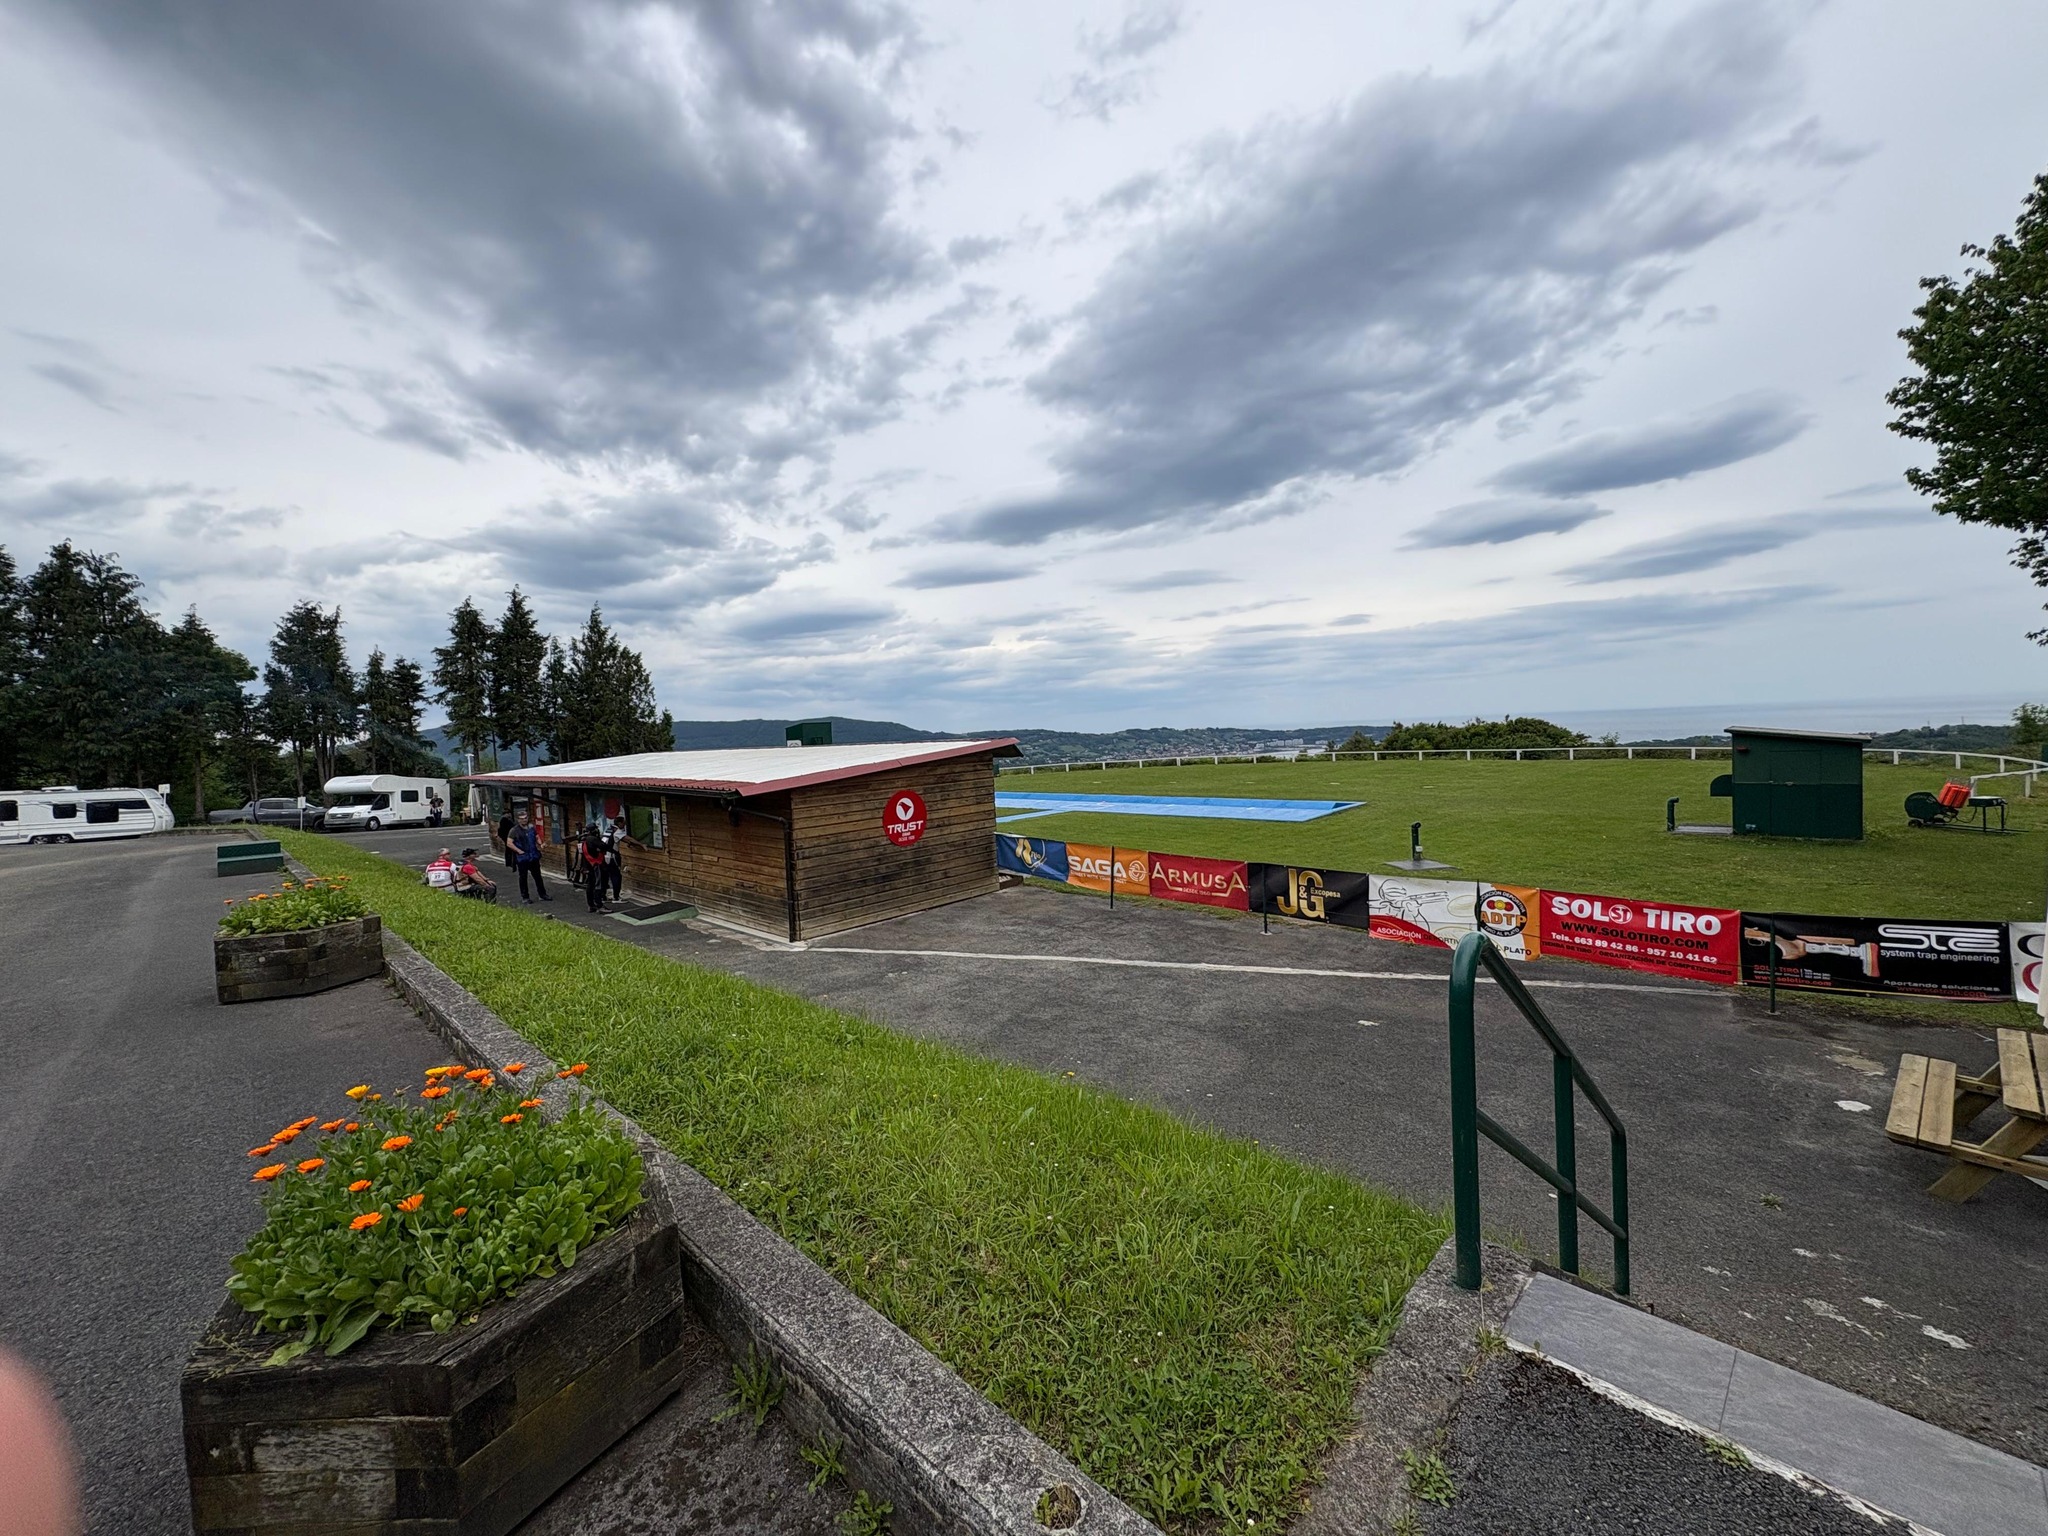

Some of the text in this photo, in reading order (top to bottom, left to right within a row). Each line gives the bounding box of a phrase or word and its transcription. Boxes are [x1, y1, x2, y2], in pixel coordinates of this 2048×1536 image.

[887, 820, 924, 834] TRUST
[1068, 855, 1127, 879] SAGA
[1152, 862, 1247, 897] ARMUSA
[1310, 887, 1341, 898] Excopesa
[1480, 910, 1527, 927] ADTP
[1643, 907, 1721, 936] TIRO
[1376, 926, 1460, 945] ASOCIACIÓN DEPORTIV
[1561, 921, 1709, 951] WWW.SOLOTIRO.COM
[1503, 945, 1532, 956] PLATO
[1551, 932, 1573, 943] Tels.
[1574, 936, 1593, 946] 663
[1595, 939, 1608, 948] 89
[1610, 941, 1623, 950] 42
[1646, 947, 1667, 957] 957
[1669, 950, 1683, 959] 10
[1685, 953, 1700, 962] 41
[1702, 955, 1718, 965] 62
[1880, 949, 2000, 964] system trap engineering
[1541, 941, 1565, 950] TIENDA
[1599, 950, 1654, 963] ORGANIZACIÓN
[1668, 961, 1732, 976] COMPETICIONES
[1883, 980, 2000, 992] Aportando soluciones
